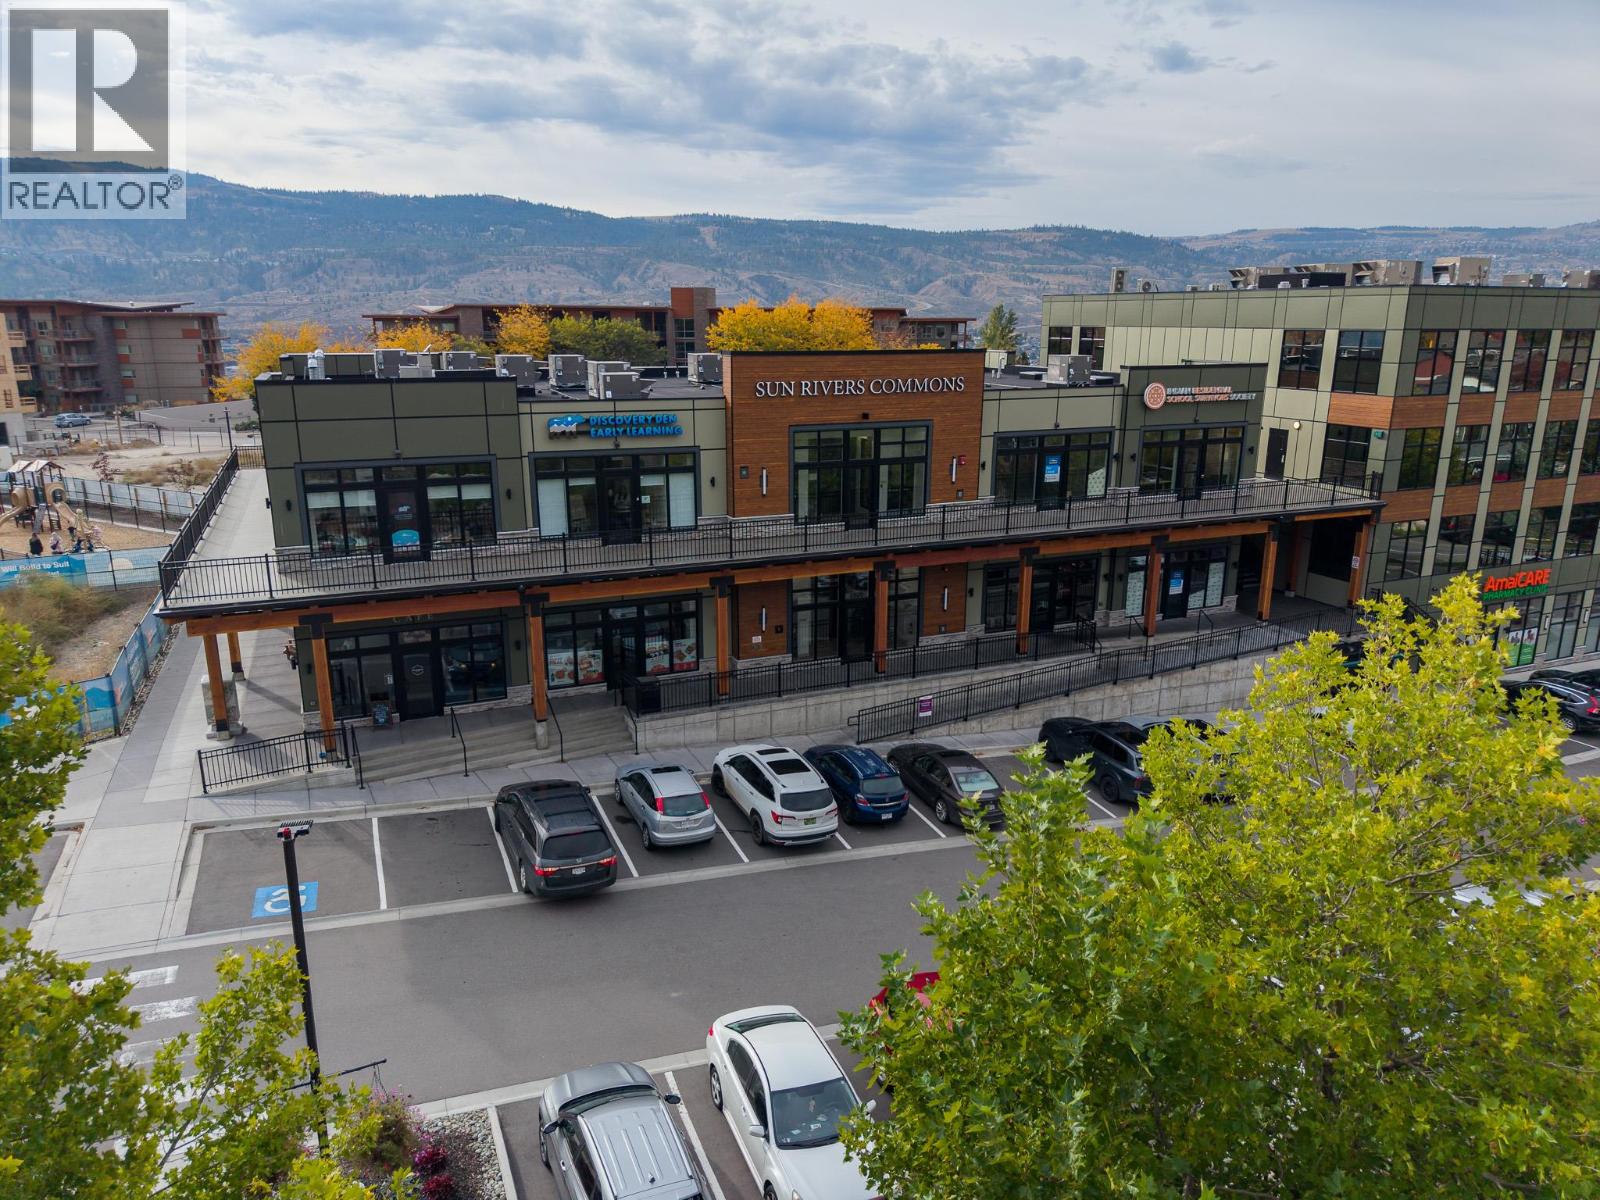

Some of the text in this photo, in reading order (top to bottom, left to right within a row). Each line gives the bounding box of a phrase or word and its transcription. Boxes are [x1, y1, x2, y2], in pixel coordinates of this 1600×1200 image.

[755, 376, 965, 398] SUN RIVERS COMMONS
[1166, 395, 1194, 403] SCHOOL
[1229, 393, 1257, 401] SOCIETY
[589, 414, 678, 426] DISCOVERY DEN
[590, 425, 683, 438] EARLY LEARNING
[20, 562, 41, 570] Build
[1484, 568, 1552, 592] AmalCARE
[1482, 588, 1526, 601] PHARMACY
